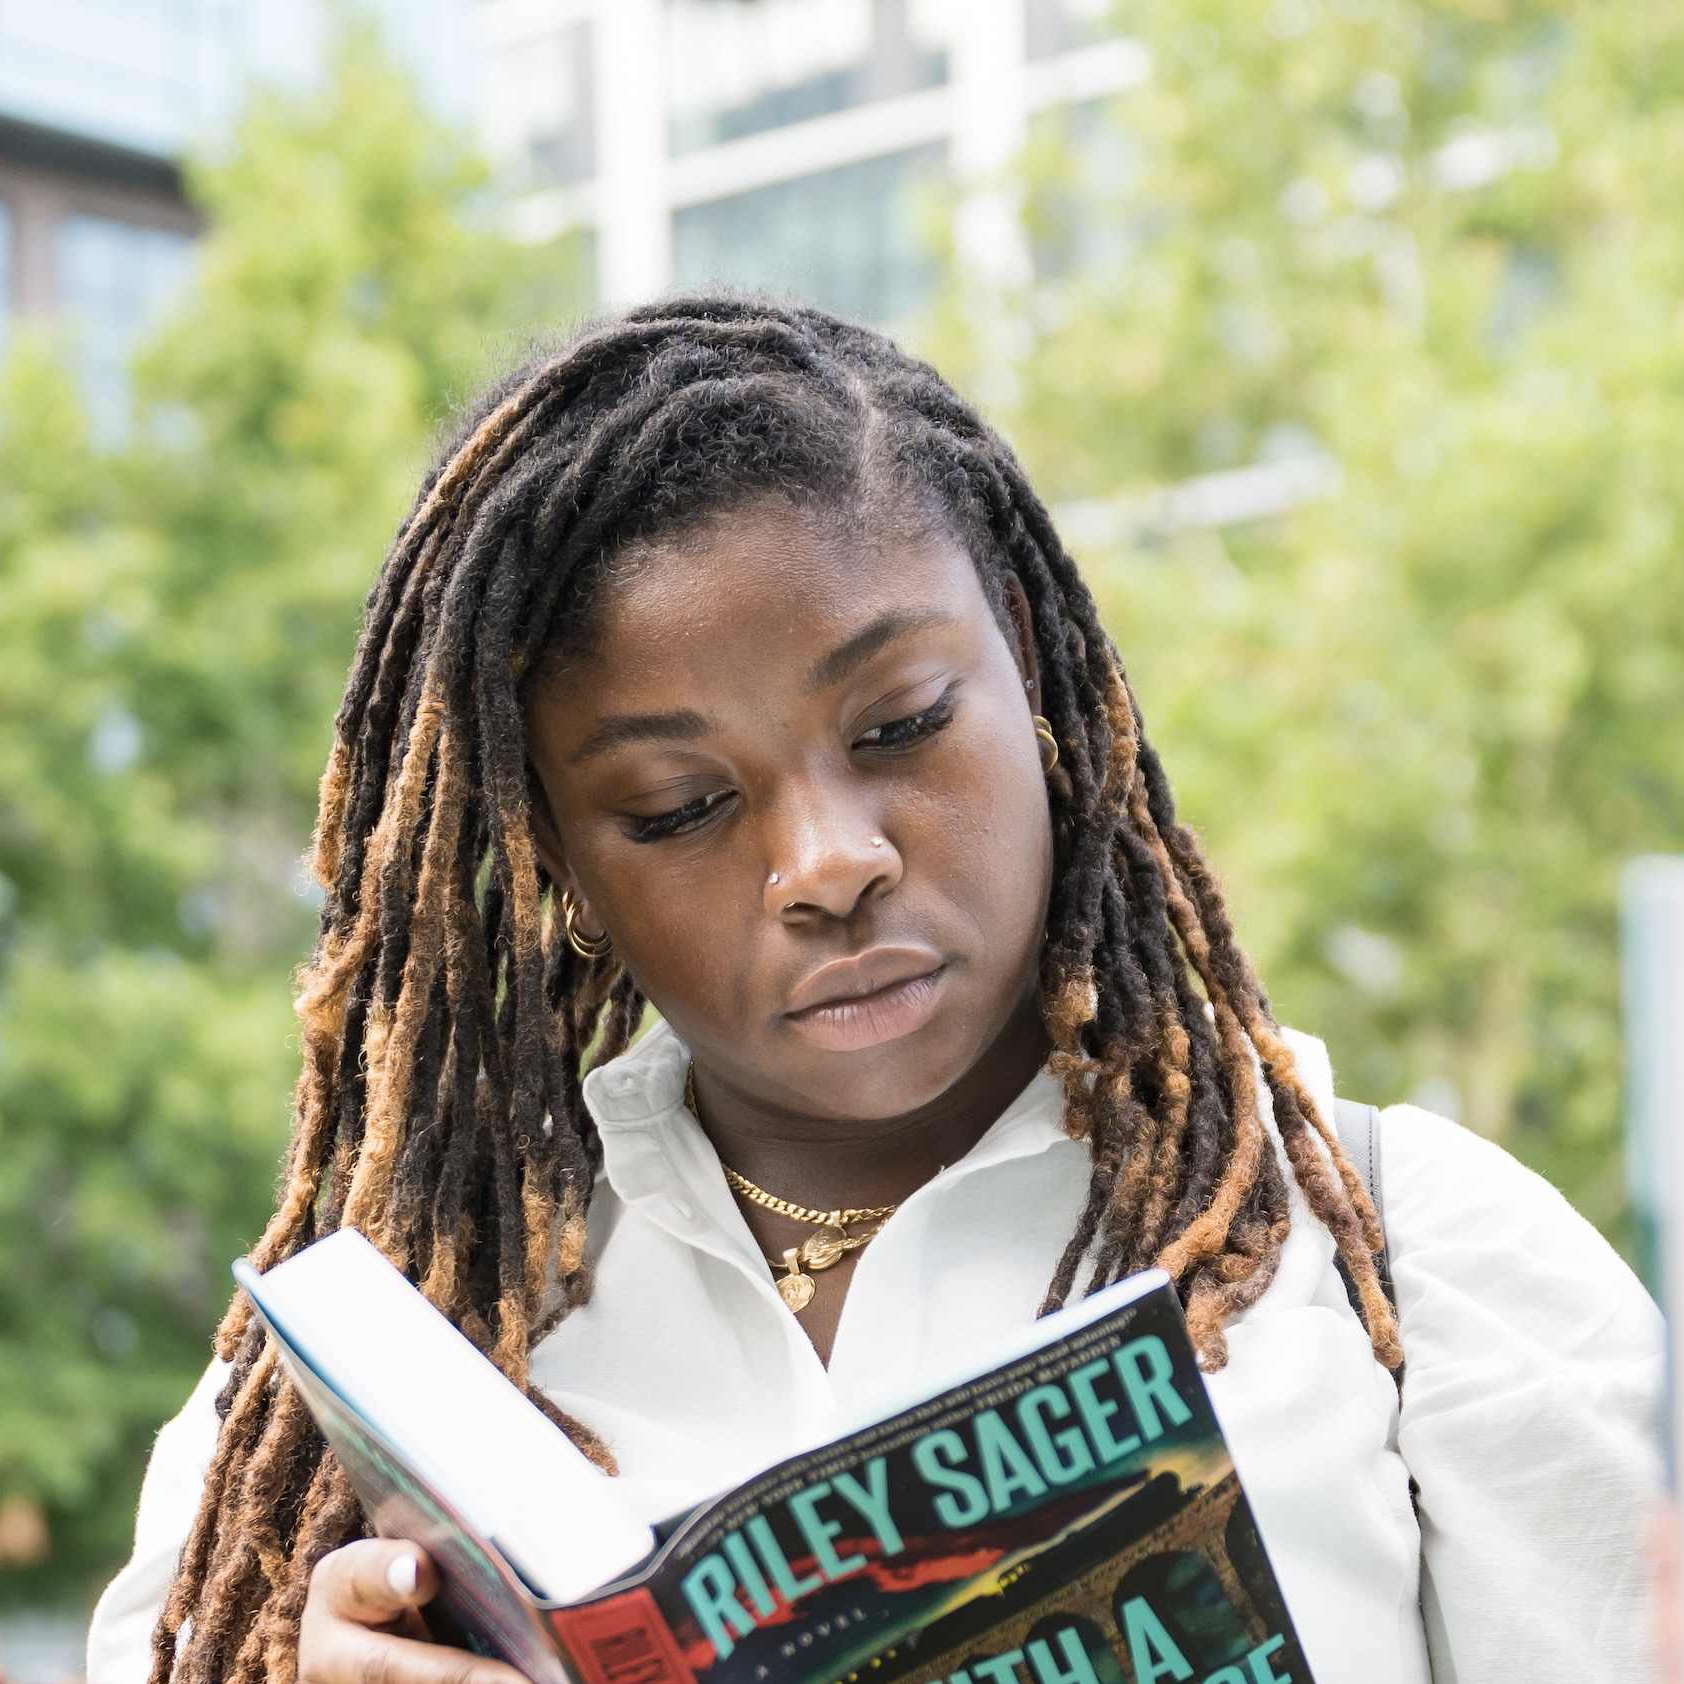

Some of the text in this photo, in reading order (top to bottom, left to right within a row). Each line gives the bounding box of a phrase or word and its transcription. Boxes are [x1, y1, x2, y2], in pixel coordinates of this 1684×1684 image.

[681, 1333, 1194, 1661] RILEY SAGER
[779, 1605, 867, 1659] NOVEL
